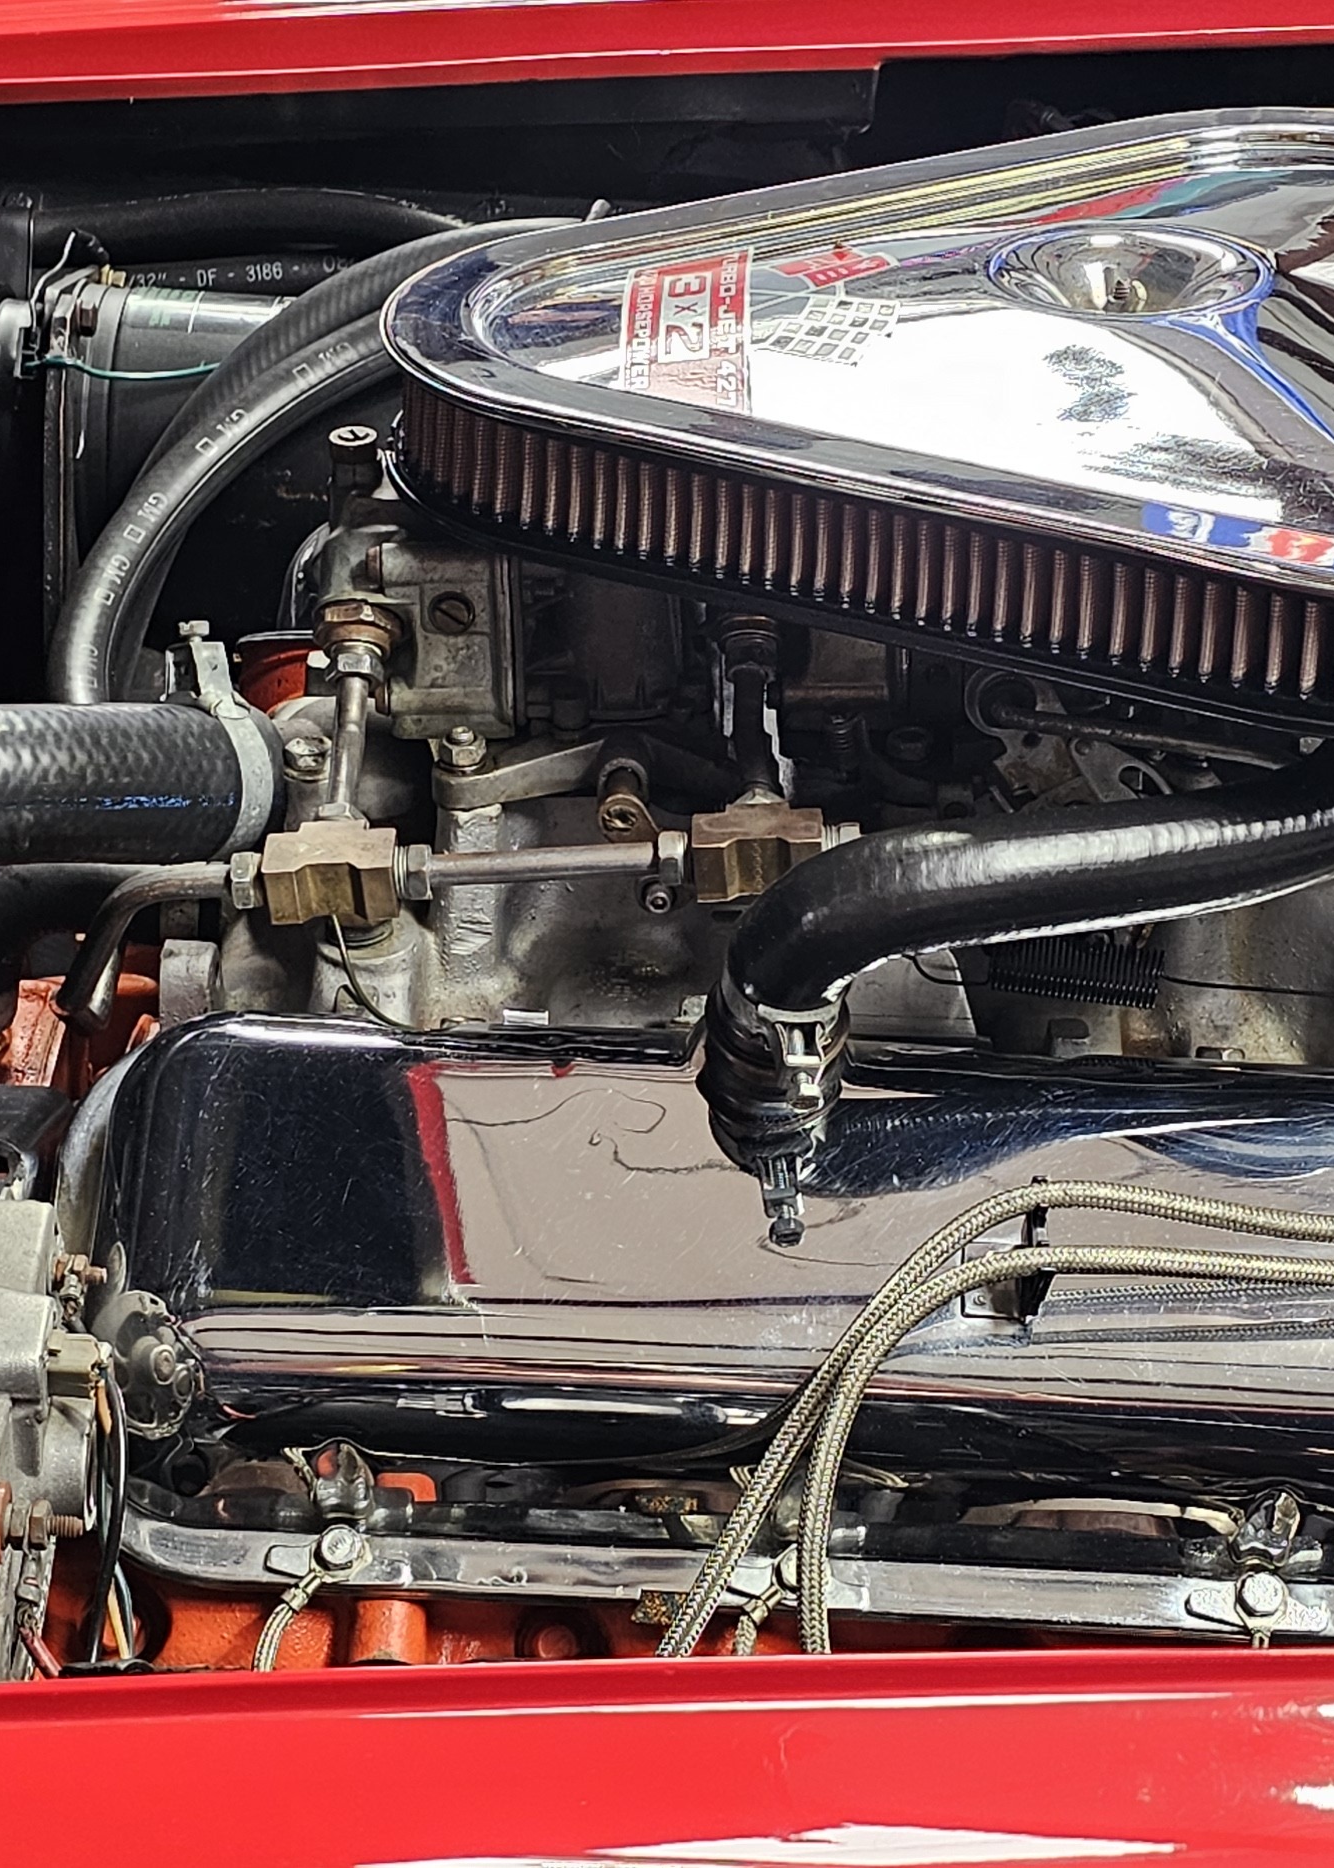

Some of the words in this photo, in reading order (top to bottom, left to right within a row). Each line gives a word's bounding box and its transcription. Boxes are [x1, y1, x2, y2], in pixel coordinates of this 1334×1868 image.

[197, 268, 218, 288] DF
[246, 261, 283, 283] 3186
[667, 274, 707, 298] 3
[630, 285, 655, 390] HORSEPOWER
[665, 322, 704, 356] 2
[717, 360, 739, 408] 427
[216, 408, 249, 440] GM
[136, 492, 167, 523] GM
[102, 554, 131, 585] GM
